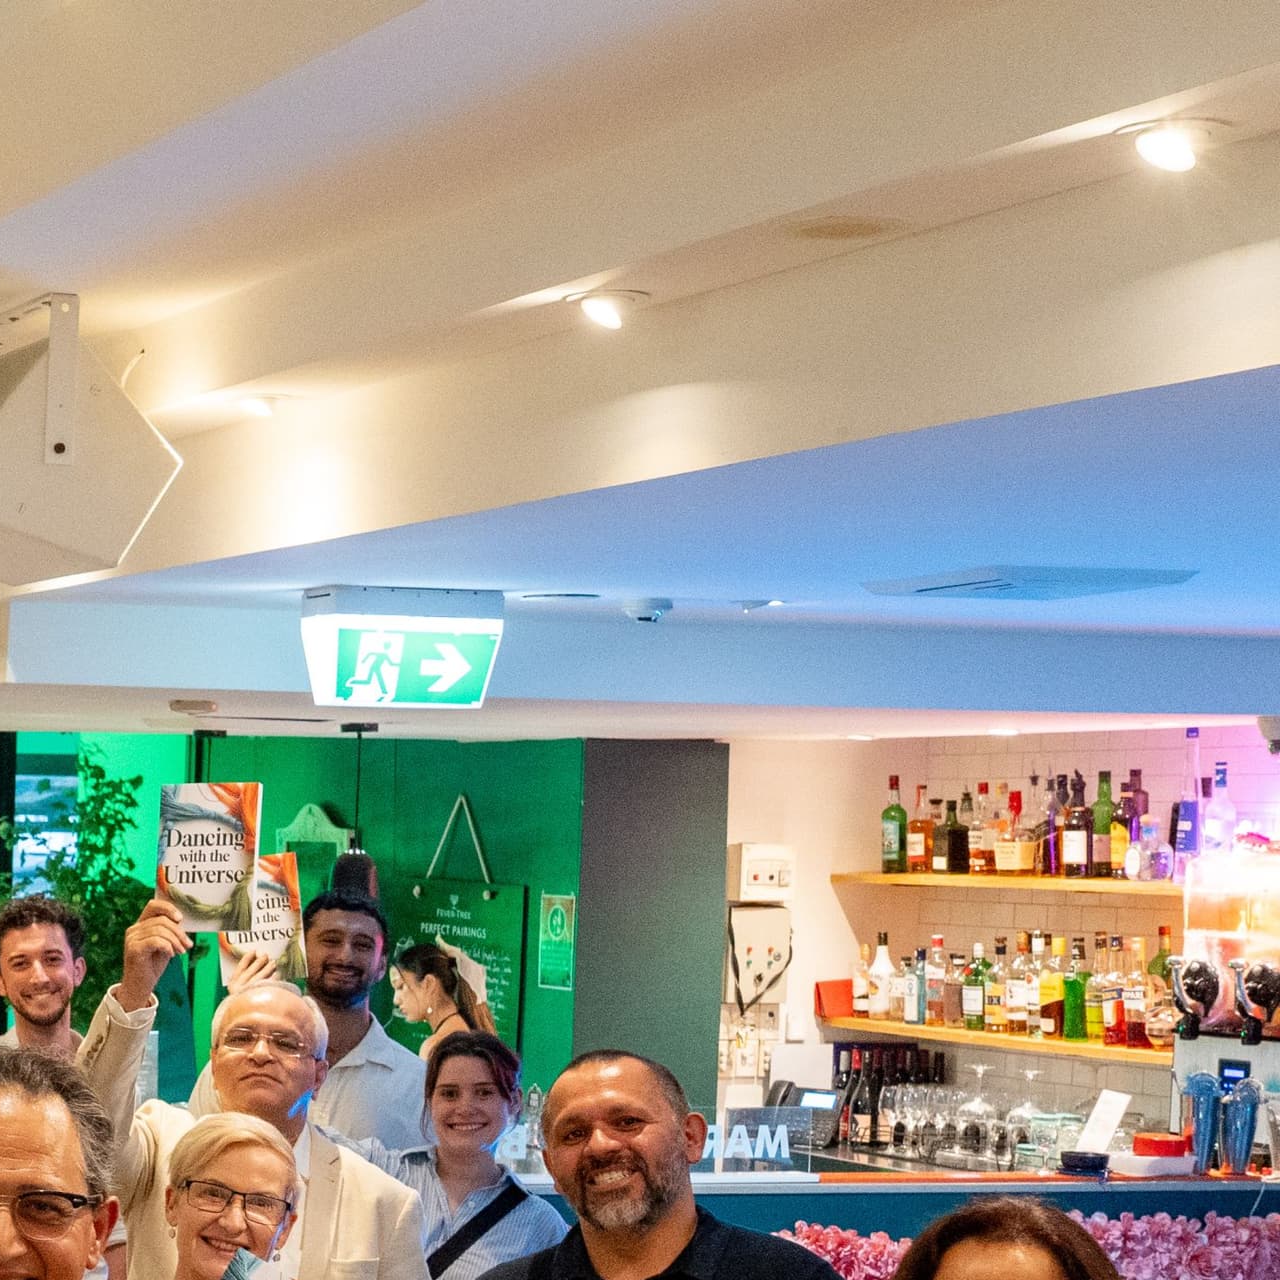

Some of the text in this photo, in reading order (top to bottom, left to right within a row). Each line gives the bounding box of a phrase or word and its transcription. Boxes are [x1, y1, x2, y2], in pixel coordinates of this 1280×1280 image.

[167, 827, 245, 850] Dancing
[179, 849, 230, 862] with the
[164, 864, 245, 884] Universe
[256, 893, 291, 911] cing
[262, 911, 281, 923] the
[420, 922, 487, 940] PERFECT PAIRINGS
